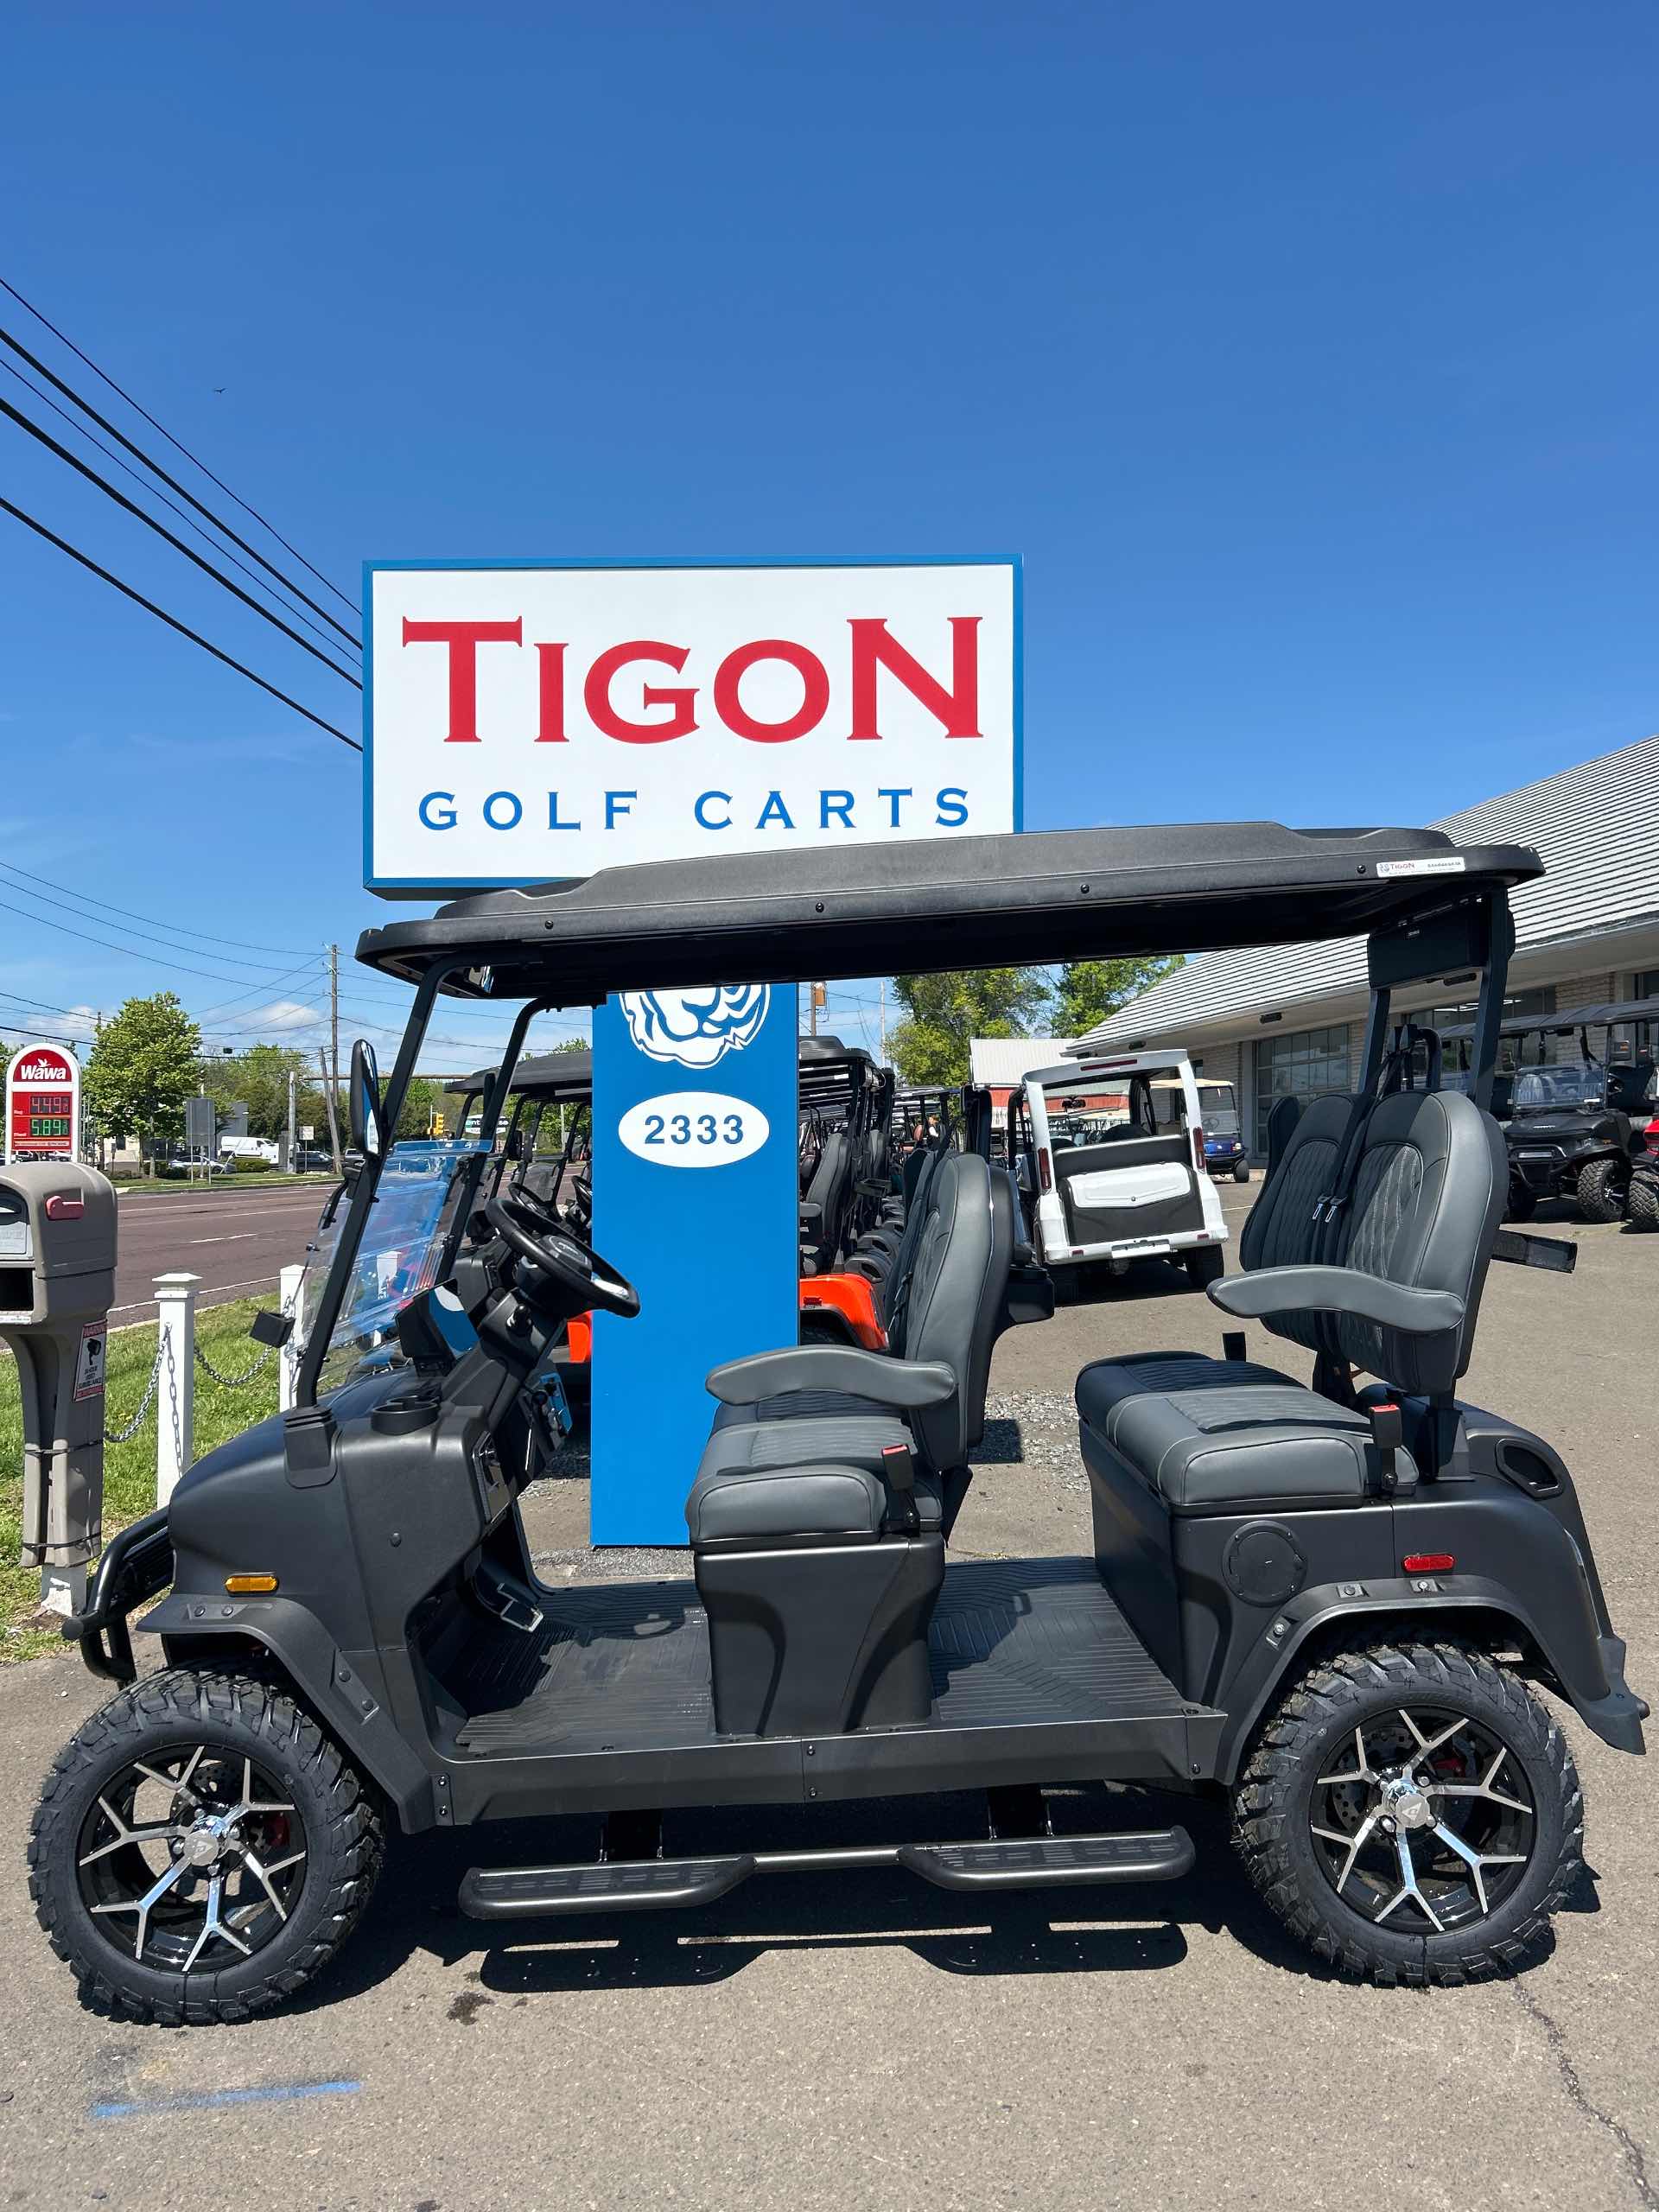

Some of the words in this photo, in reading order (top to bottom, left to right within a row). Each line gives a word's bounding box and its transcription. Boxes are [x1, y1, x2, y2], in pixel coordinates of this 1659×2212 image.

[403, 616, 983, 743] TIGON
[418, 790, 638, 830] GOLF
[695, 787, 969, 830] CARTS
[21, 1065, 67, 1080] Wawa
[645, 1115, 744, 1145] 2333
